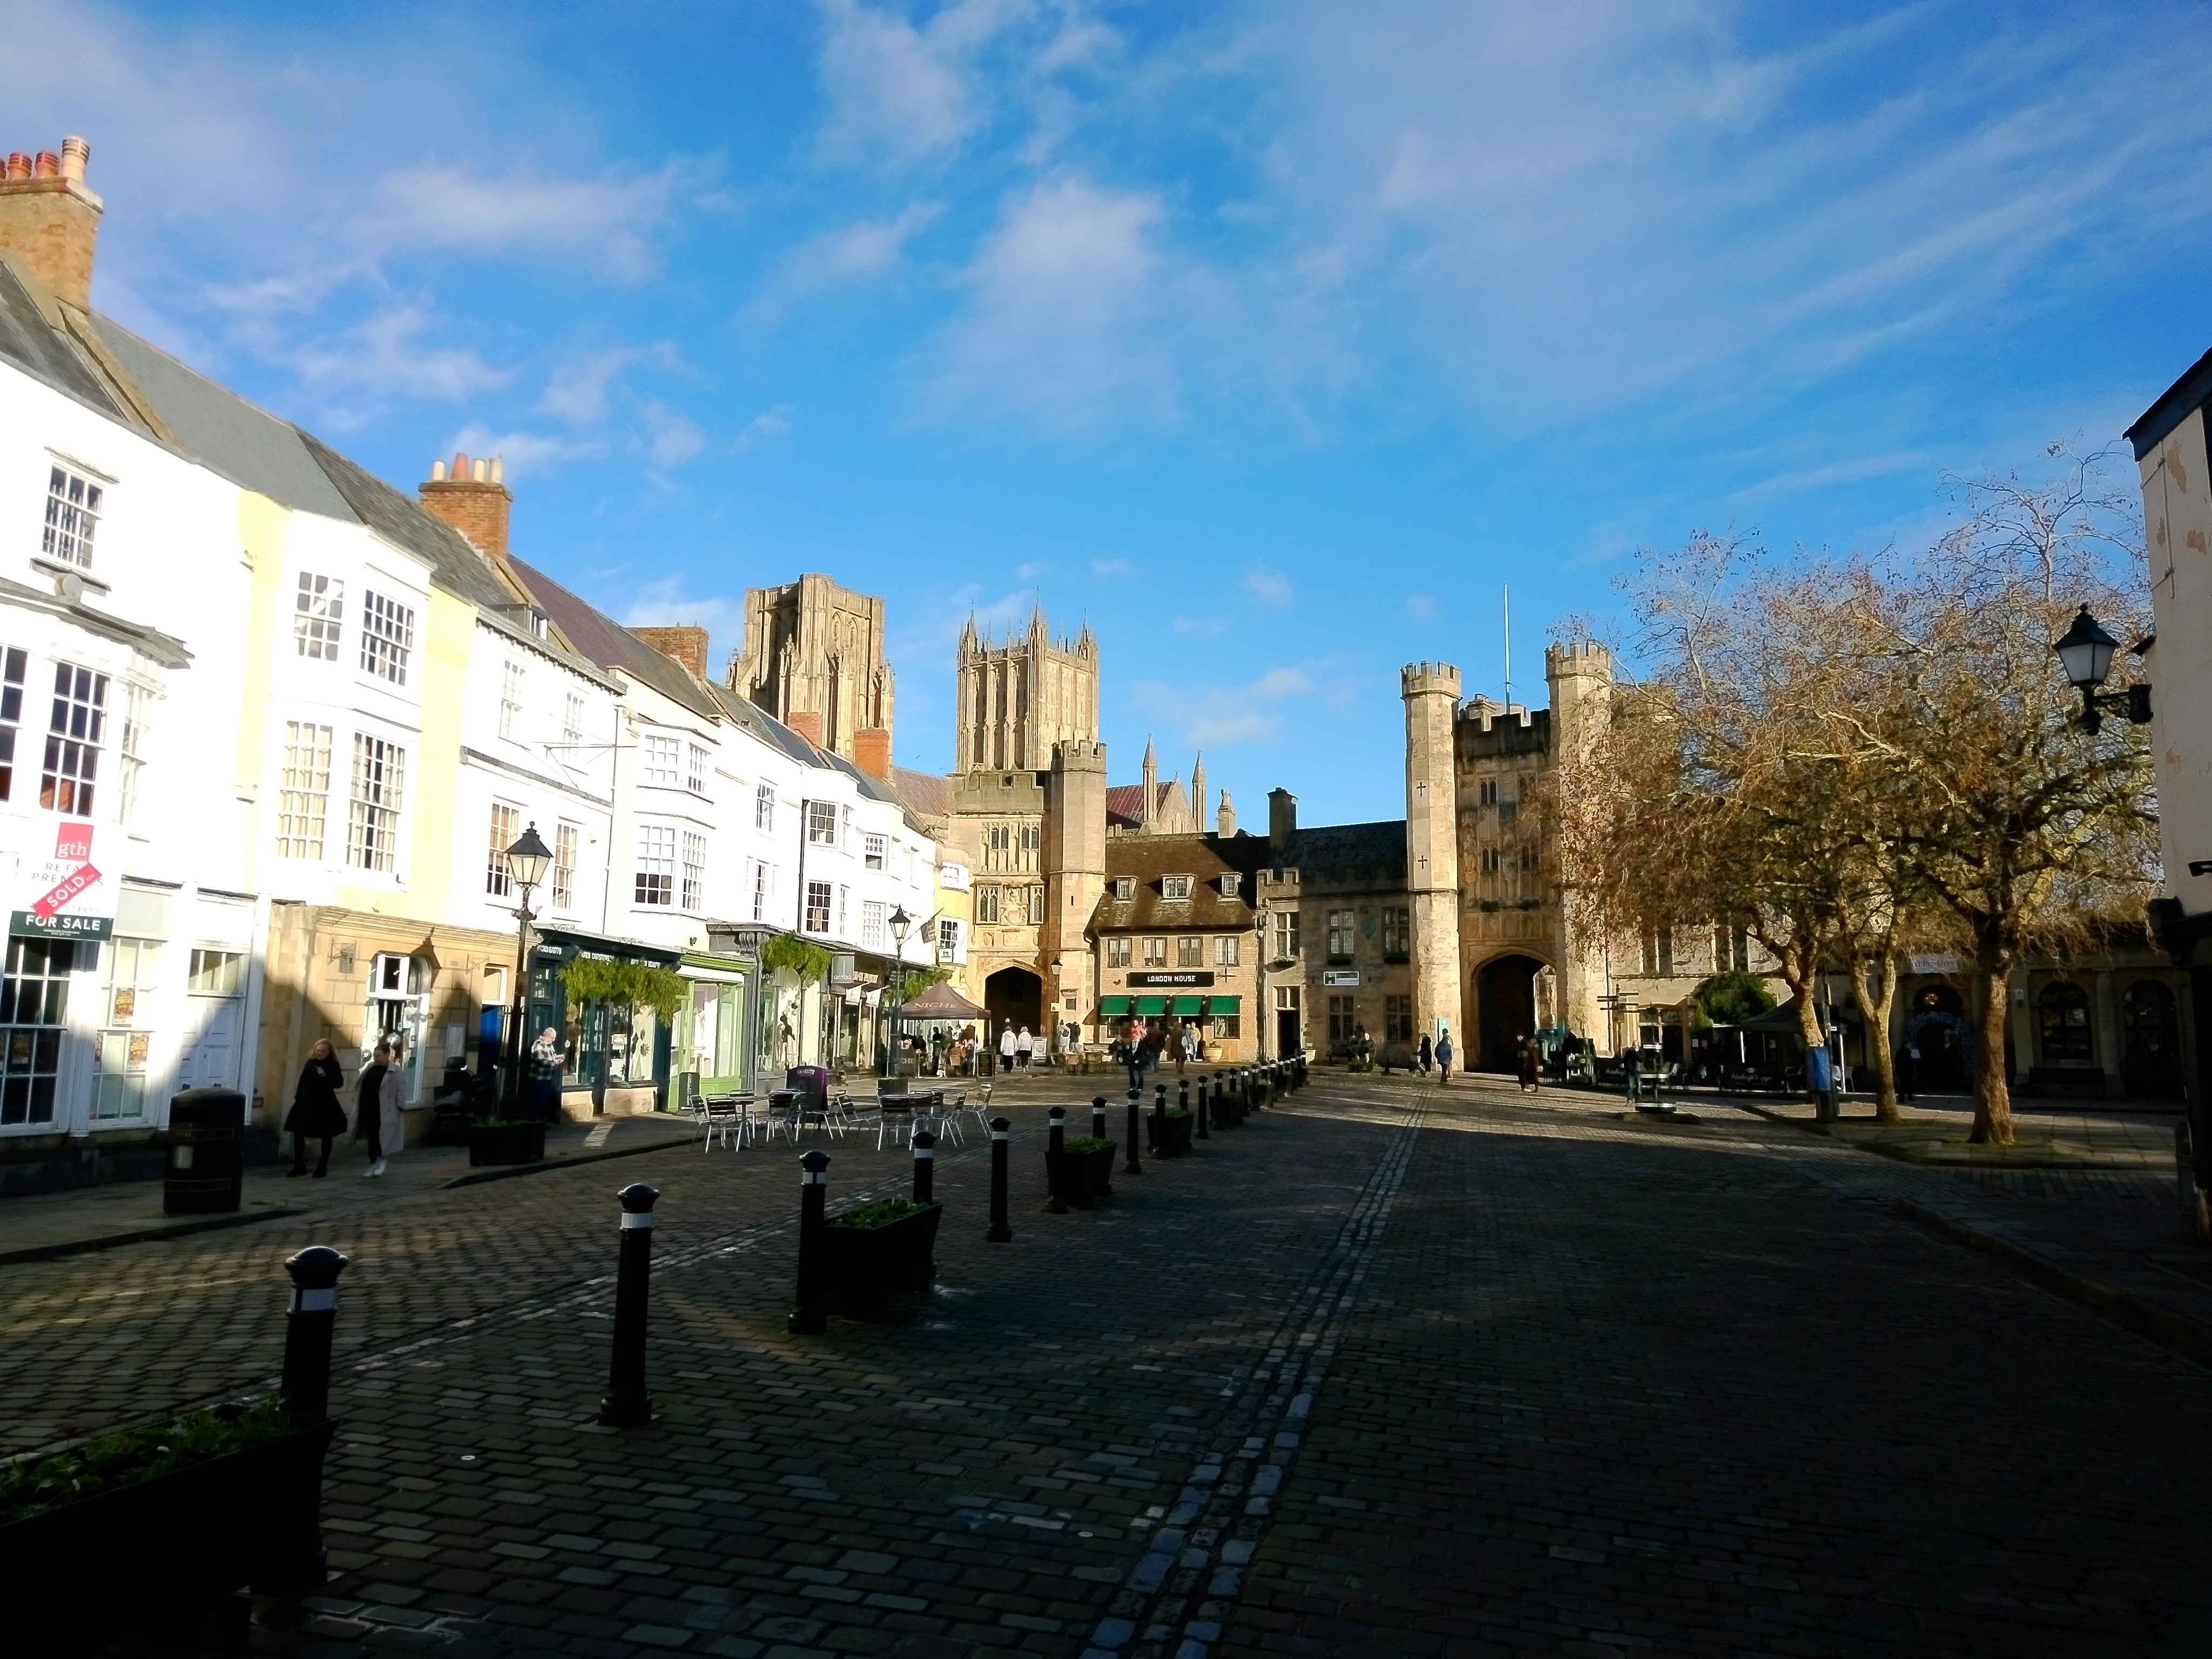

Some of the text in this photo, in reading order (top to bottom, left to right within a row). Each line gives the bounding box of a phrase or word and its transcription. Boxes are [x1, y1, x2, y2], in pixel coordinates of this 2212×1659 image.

[57, 841, 87, 858] gth
[45, 862, 80, 873] RETA
[46, 876, 85, 908] SOLD
[25, 914, 101, 931] FOR SALE
[117, 997, 133, 1006] CIRCUS
[131, 1044, 147, 1052] CIRCUS
